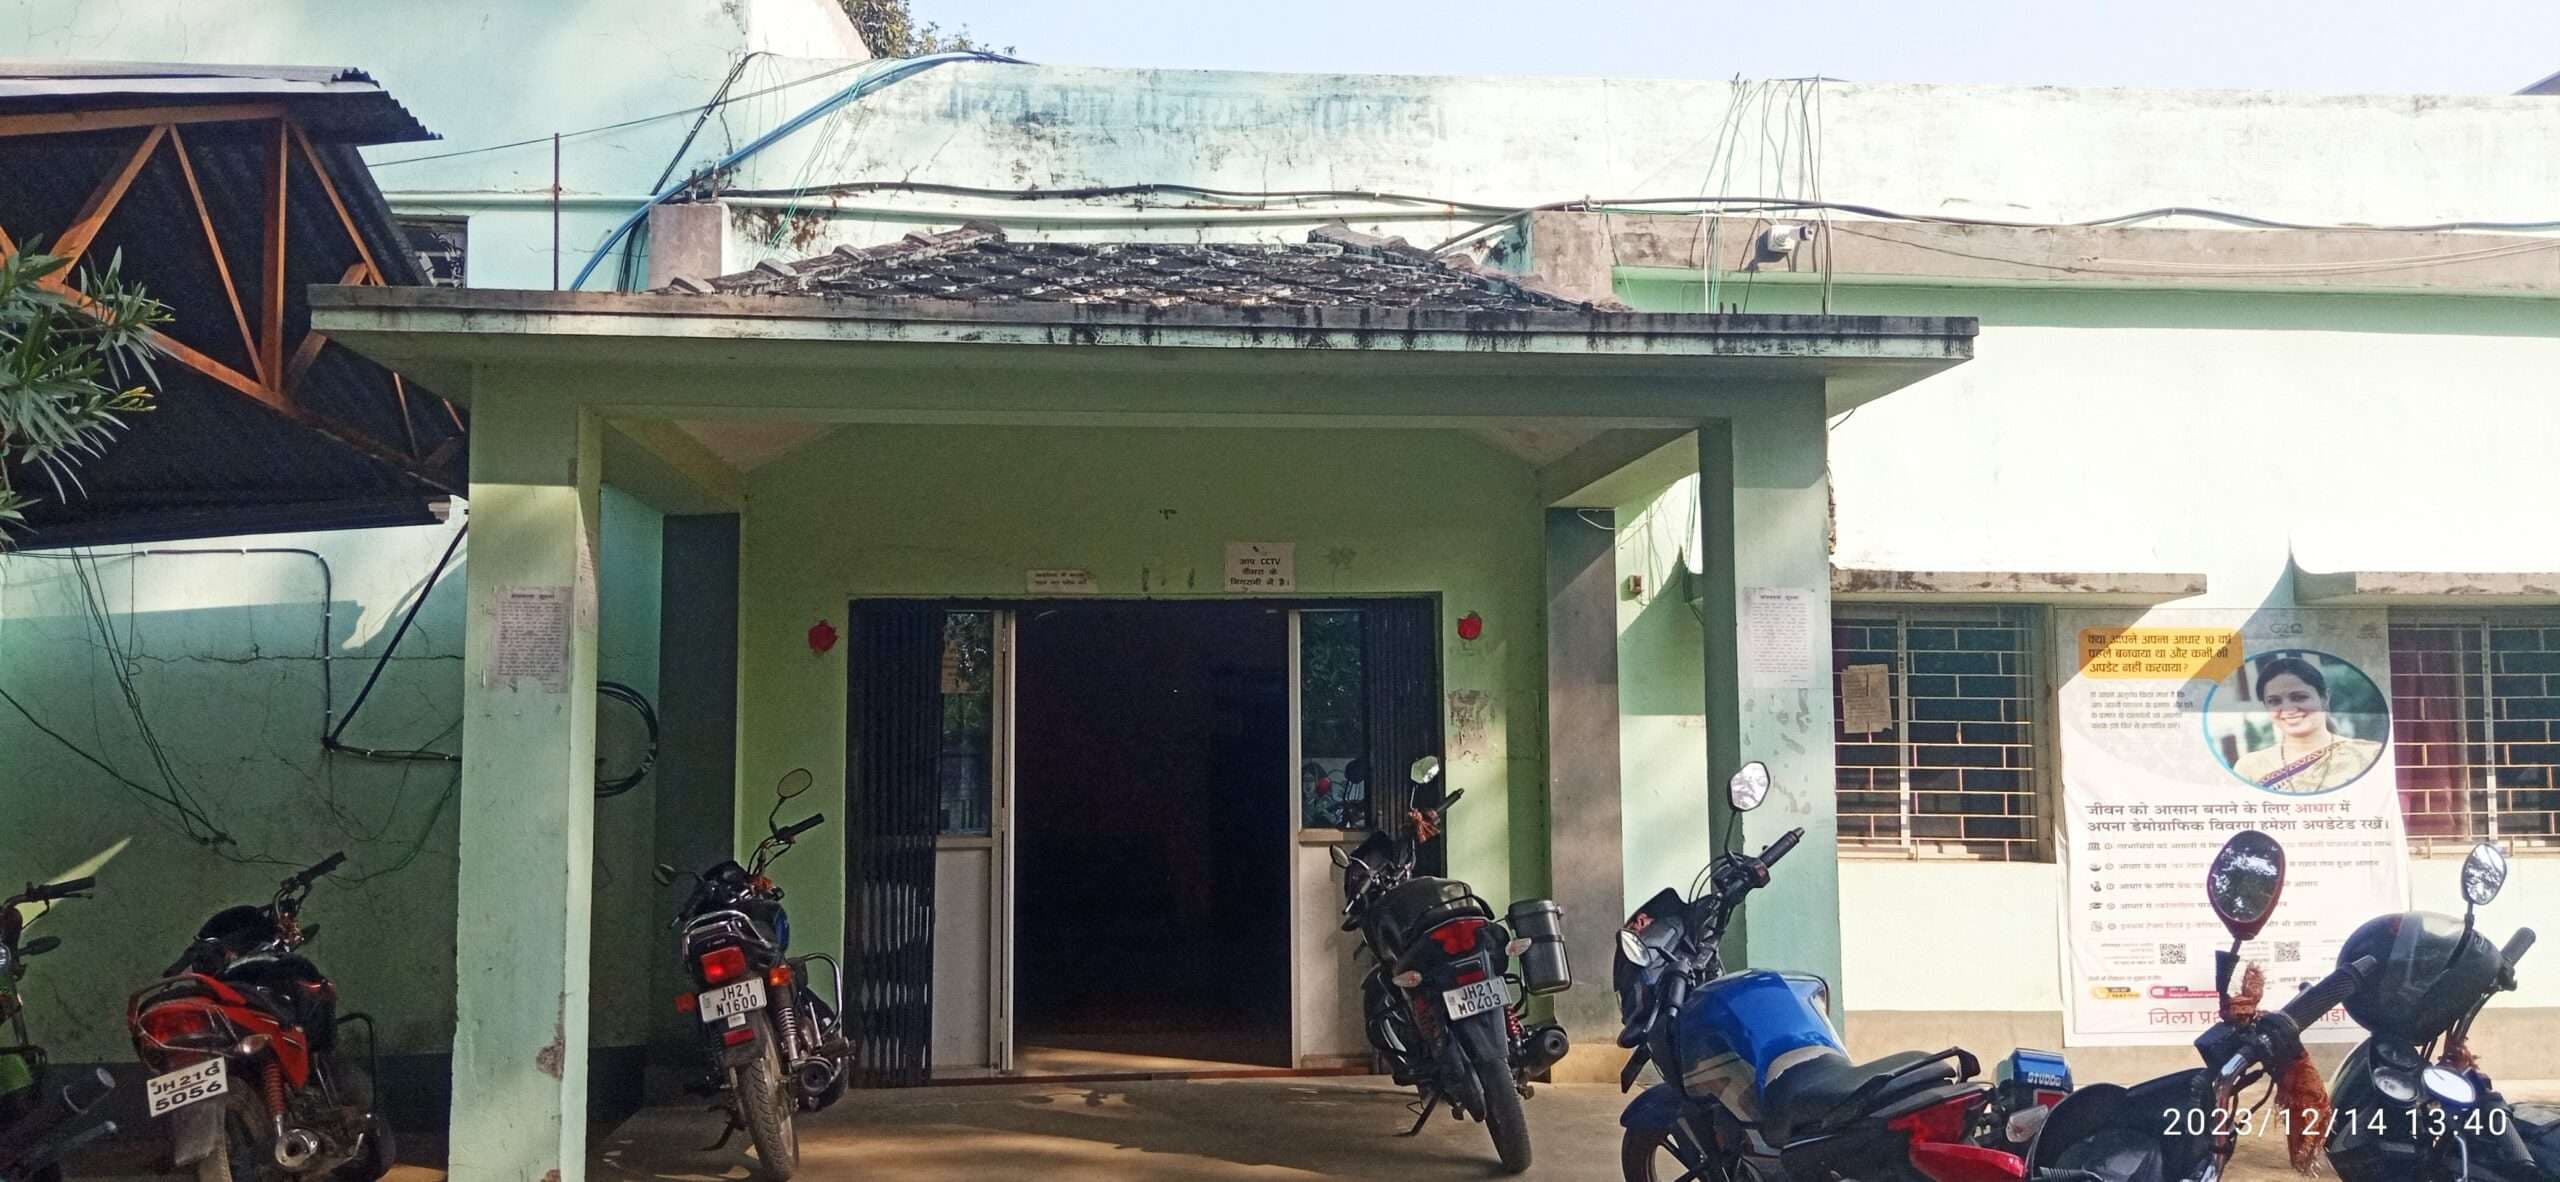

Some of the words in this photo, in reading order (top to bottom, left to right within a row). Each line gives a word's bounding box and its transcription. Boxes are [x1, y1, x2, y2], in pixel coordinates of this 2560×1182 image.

[1260, 557, 1281, 566] CCTV
[2087, 634, 2106, 644] क्या
[2142, 634, 2169, 644] अपना
[2174, 634, 2201, 644] आधार
[2204, 635, 2215, 644] 10
[2115, 649, 2151, 658] बनवाया
[2170, 647, 2188, 658] और
[2089, 662, 2119, 673] अपडेट
[2085, 802, 2125, 816] जीवन
[2128, 801, 2149, 815] को
[2154, 804, 2198, 815] आसान
[2202, 800, 2239, 815] बनाने
[2243, 800, 2258, 814] के
[2262, 800, 2291, 815] लिए
[2296, 803, 2336, 814] आधार
[2339, 799, 2351, 813] में
[2087, 821, 2126, 832] अपना
[2129, 818, 2205, 832] डेमोग्राफिक
[2209, 818, 2256, 831] विवरण
[2259, 817, 2297, 831] हमेशा
[2303, 816, 2356, 830] अपडेटेड
[720, 983, 751, 1002] JH21
[1461, 982, 1494, 1001] JH21
[716, 994, 758, 1017] N1600
[2148, 1007, 2194, 1025] जिला
[155, 1081, 222, 1112] 5056
